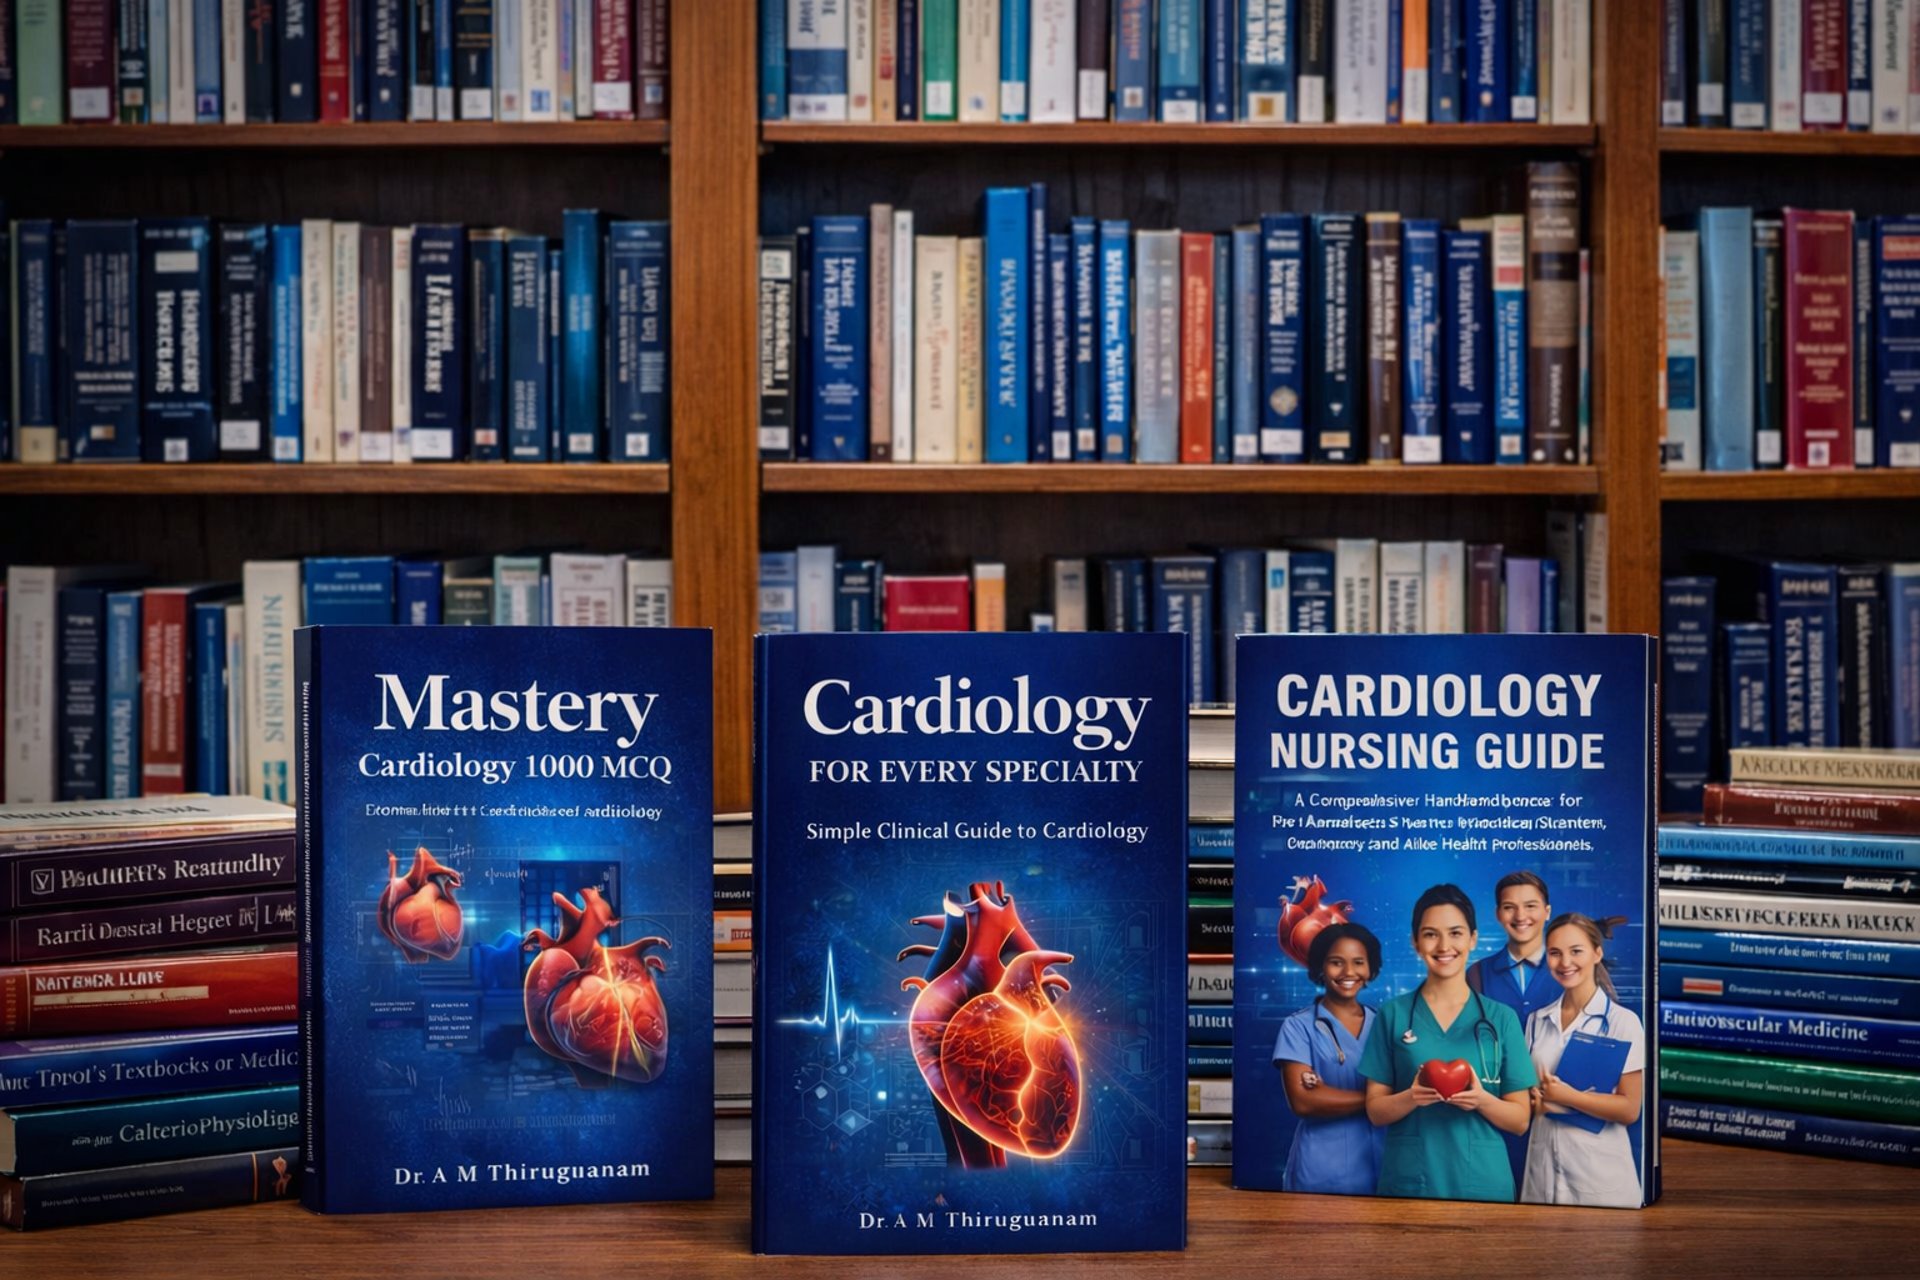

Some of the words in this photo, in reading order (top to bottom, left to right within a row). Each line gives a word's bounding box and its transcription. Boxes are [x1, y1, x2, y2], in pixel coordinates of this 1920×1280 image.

[1276, 673, 1602, 718] CARDIOLOGY
[373, 673, 660, 748] Mastery
[803, 674, 1152, 751] Cardiology
[1270, 732, 1460, 770] NURSING
[1475, 732, 1605, 770] GUIDE
[358, 752, 517, 785] Cardiology
[525, 754, 595, 779] 1000
[601, 755, 673, 785] MCQ
[809, 760, 872, 783] FOR
[880, 760, 977, 783] EVERY
[985, 759, 1144, 783] SPECIALTY
[1294, 793, 1305, 807] A
[1559, 793, 1583, 807] for
[806, 821, 872, 844] Simple
[877, 821, 949, 840] Clinical
[954, 821, 1012, 840] Guide
[1016, 824, 1037, 840] to
[1043, 821, 1150, 844] Cardiology
[1788, 1018, 1869, 1041] Medicine
[395, 1167, 426, 1185] Dr.
[432, 1166, 448, 1184] A
[457, 1165, 478, 1182] M
[488, 1163, 651, 1184] Thiruguanam
[859, 1212, 889, 1229] Dr.
[893, 1213, 907, 1229] A
[916, 1212, 935, 1228] M
[945, 1211, 1098, 1232] Thiruguanam
